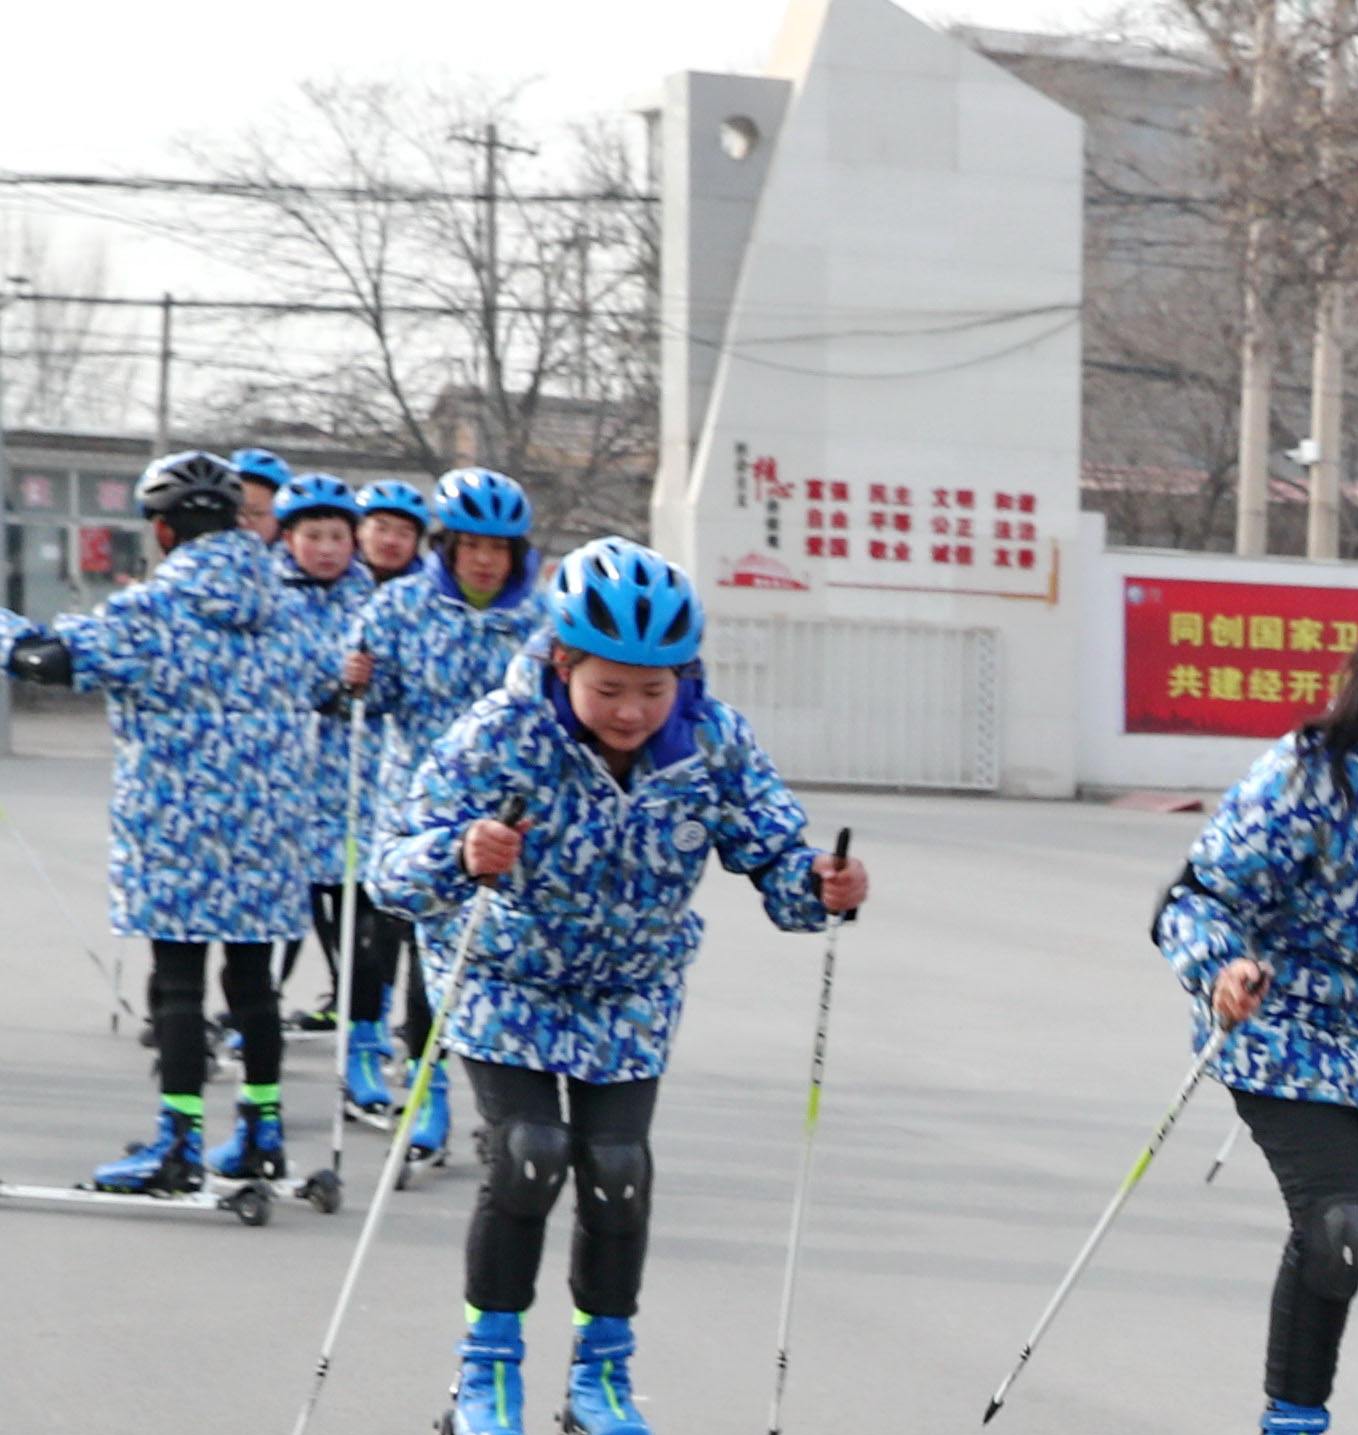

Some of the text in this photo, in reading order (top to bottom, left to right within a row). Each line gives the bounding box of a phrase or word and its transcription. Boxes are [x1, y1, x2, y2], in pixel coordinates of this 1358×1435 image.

[806, 479, 848, 500] 富强
[869, 484, 911, 505] 民主
[932, 489, 974, 508] 文明
[807, 508, 1036, 541] 自由 平等 公正 法治
[807, 537, 1036, 570] 爱国 敬业 诚信 友善
